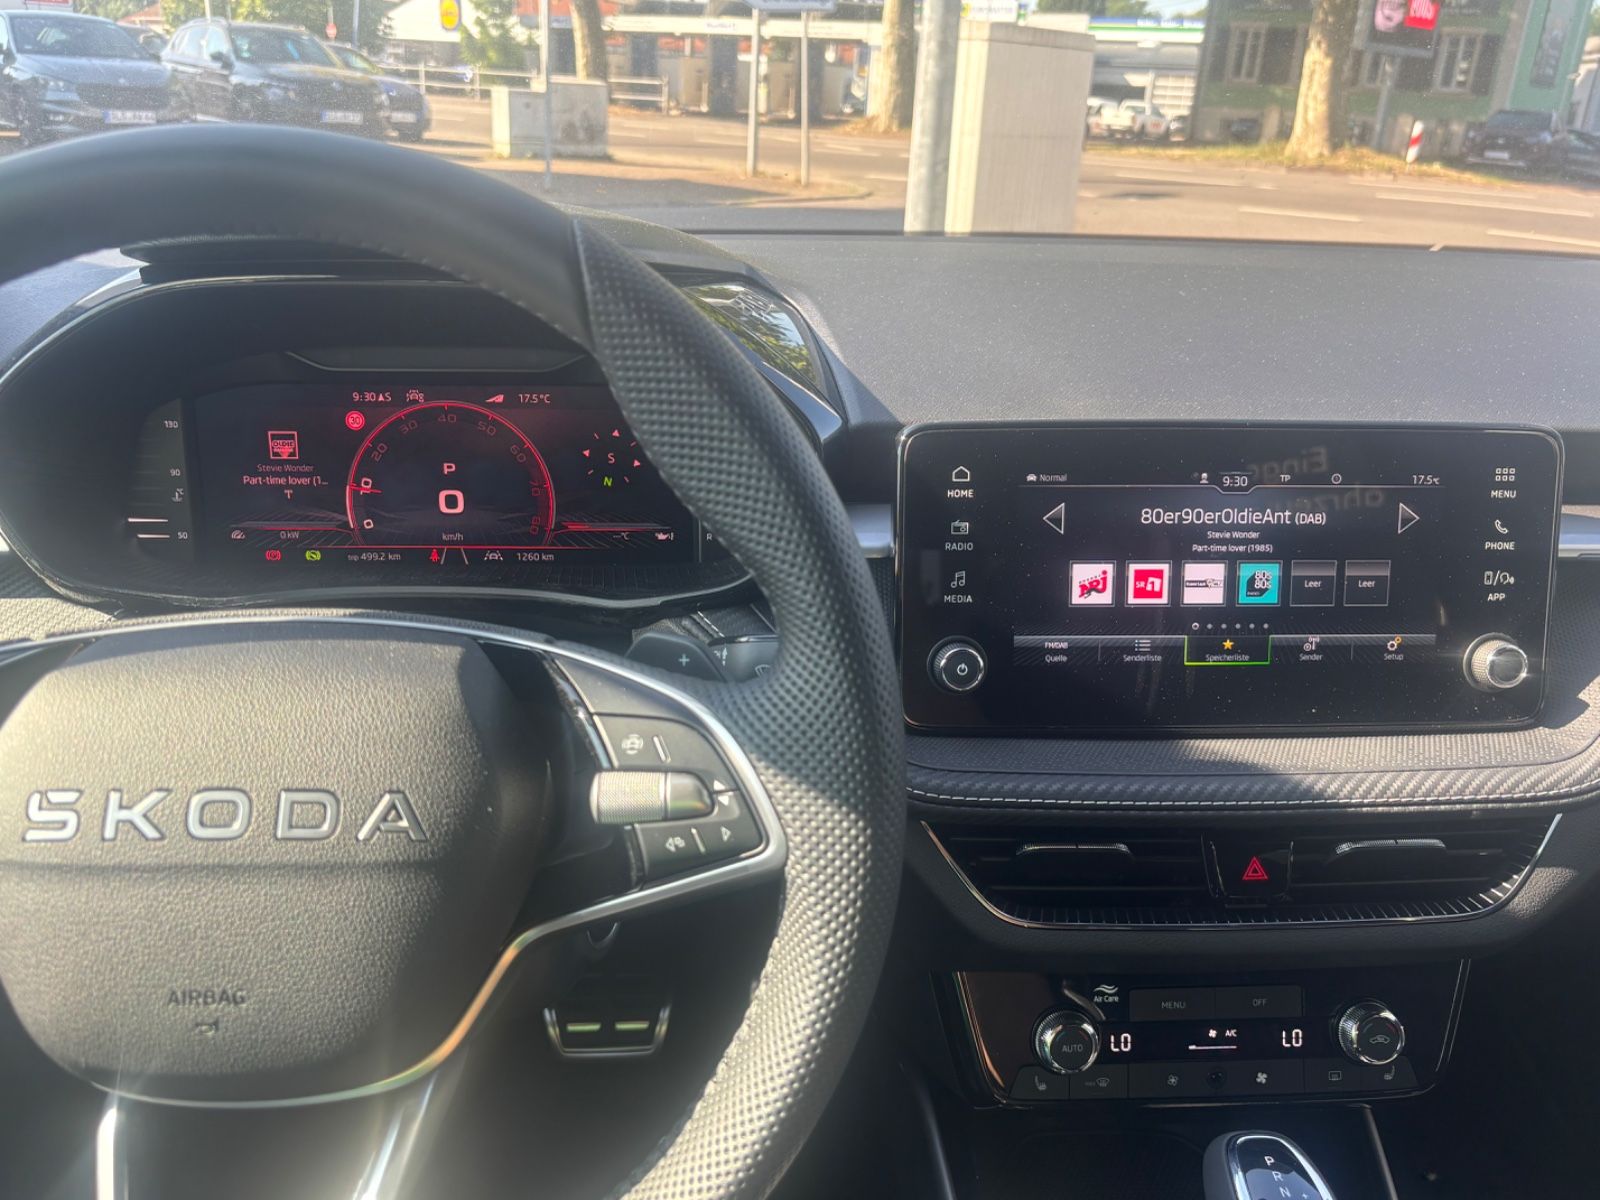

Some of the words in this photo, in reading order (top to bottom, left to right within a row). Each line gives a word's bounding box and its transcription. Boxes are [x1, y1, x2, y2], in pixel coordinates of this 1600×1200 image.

[352, 392, 376, 402] 9:30
[518, 394, 551, 403] 17.5°C
[437, 413, 457, 424] 40
[164, 420, 179, 429] 130
[399, 419, 421, 434] 30
[477, 420, 497, 436] 50
[371, 443, 388, 462] 20
[510, 444, 527, 464] 60
[607, 453, 615, 464] S
[170, 468, 181, 477] 90
[256, 464, 282, 473] Stevie
[284, 464, 314, 473] Wonder
[443, 463, 456, 475] P
[243, 475, 287, 485] Part-time
[288, 475, 311, 485] lover
[603, 476, 613, 487] N
[1040, 473, 1068, 482] Normal
[1222, 475, 1248, 487] 9:30
[1279, 474, 1291, 483] TP
[947, 489, 974, 498] HOME
[1490, 490, 1517, 499] MENU
[438, 489, 465, 514] 0
[1140, 507, 1291, 525] 80er90erOldieAnt
[1294, 512, 1327, 526] (DAB)
[363, 519, 374, 529] 0
[177, 531, 188, 540] 50
[287, 531, 300, 540] kW
[442, 532, 464, 542] km/h
[1207, 530, 1230, 539] Stevie
[1231, 530, 1260, 539] Wonder
[945, 542, 974, 551] RADIO
[1192, 543, 1227, 552] Part-time
[1229, 543, 1247, 552] lover
[1247, 543, 1273, 553] (1985)
[1485, 541, 1515, 550] PHONE
[360, 552, 386, 561] 499.2
[388, 552, 401, 561] km
[516, 552, 539, 562] 1260
[541, 552, 555, 561] km
[1254, 579, 1272, 589] 80s
[1304, 579, 1322, 588] Leer
[1358, 579, 1376, 588] Leer
[944, 594, 973, 603] MEDIA
[1487, 592, 1506, 602] APP
[1045, 654, 1067, 663] Quelle
[1123, 654, 1162, 662] Senderliste
[1205, 653, 1250, 663] Speicherliste
[1299, 653, 1323, 662] Sender
[1384, 653, 1404, 663] Setup
[167, 988, 248, 1008] AIRBAG
[1094, 995, 1103, 1003] Air
[1105, 995, 1119, 1003] Care
[1252, 998, 1268, 1007] OFF
[1161, 1001, 1186, 1009] MENU
[1225, 1029, 1238, 1037] A/C
[1281, 1028, 1303, 1048] LO
[1110, 1033, 1132, 1052] LO
[1062, 1043, 1084, 1053] AUTO
[1264, 1155, 1275, 1166] P
[1272, 1171, 1284, 1182] R
[1279, 1186, 1292, 1198] N
